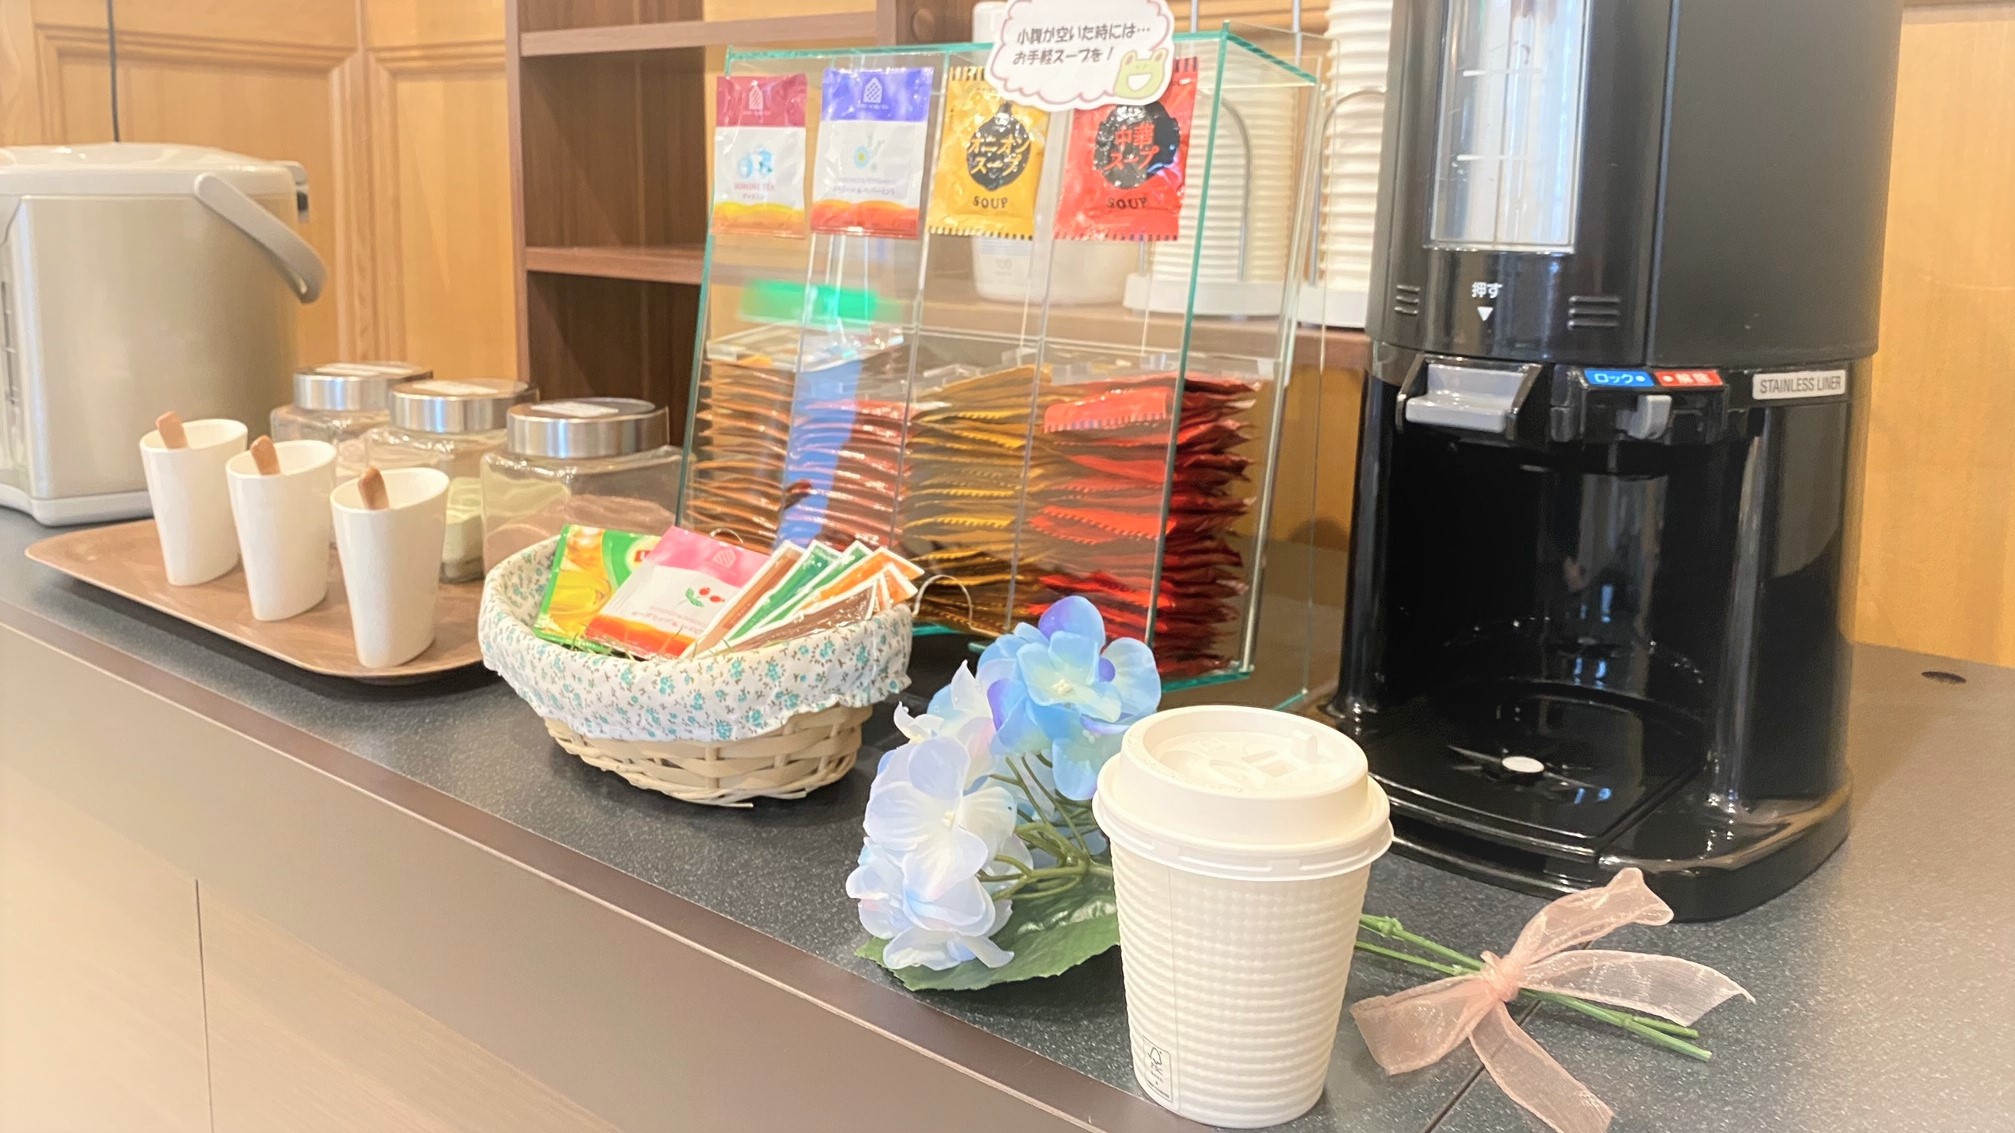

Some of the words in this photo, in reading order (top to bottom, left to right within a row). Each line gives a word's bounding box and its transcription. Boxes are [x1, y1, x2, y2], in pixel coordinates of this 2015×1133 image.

[1114, 122, 1155, 150] 中華
[967, 136, 1031, 154] オニオン
[970, 153, 1022, 176] スープ
[1105, 145, 1160, 171] スープ
[973, 196, 1008, 208] SOUP
[1107, 197, 1148, 209] SOUP
[1471, 281, 1503, 298] 押す
[1594, 373, 1633, 384] ロック
[1760, 377, 1815, 393] STAINLESS
[1817, 376, 1841, 391] LINER
